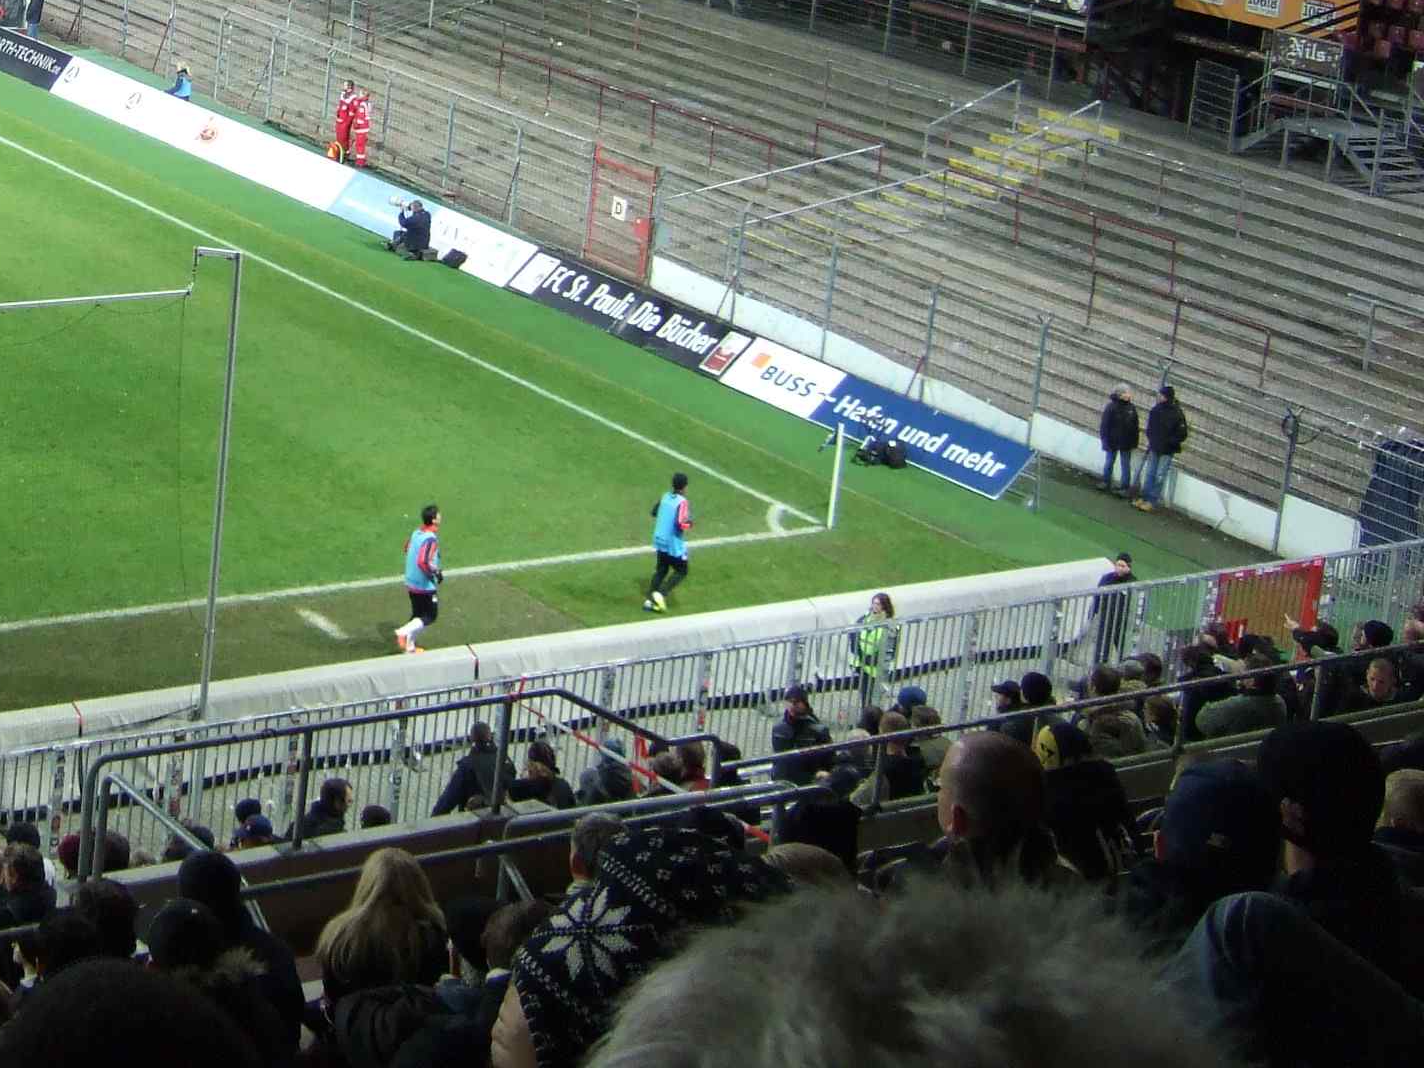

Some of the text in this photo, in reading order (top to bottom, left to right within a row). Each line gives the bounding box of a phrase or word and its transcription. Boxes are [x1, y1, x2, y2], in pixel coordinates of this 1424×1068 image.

[542, 266, 576, 294] FC
[562, 274, 590, 302] St.
[627, 301, 661, 332] Die
[656, 314, 718, 354] Bücher
[760, 365, 816, 397] BUSS
[898, 424, 947, 453] und
[942, 444, 1006, 477] mehr
